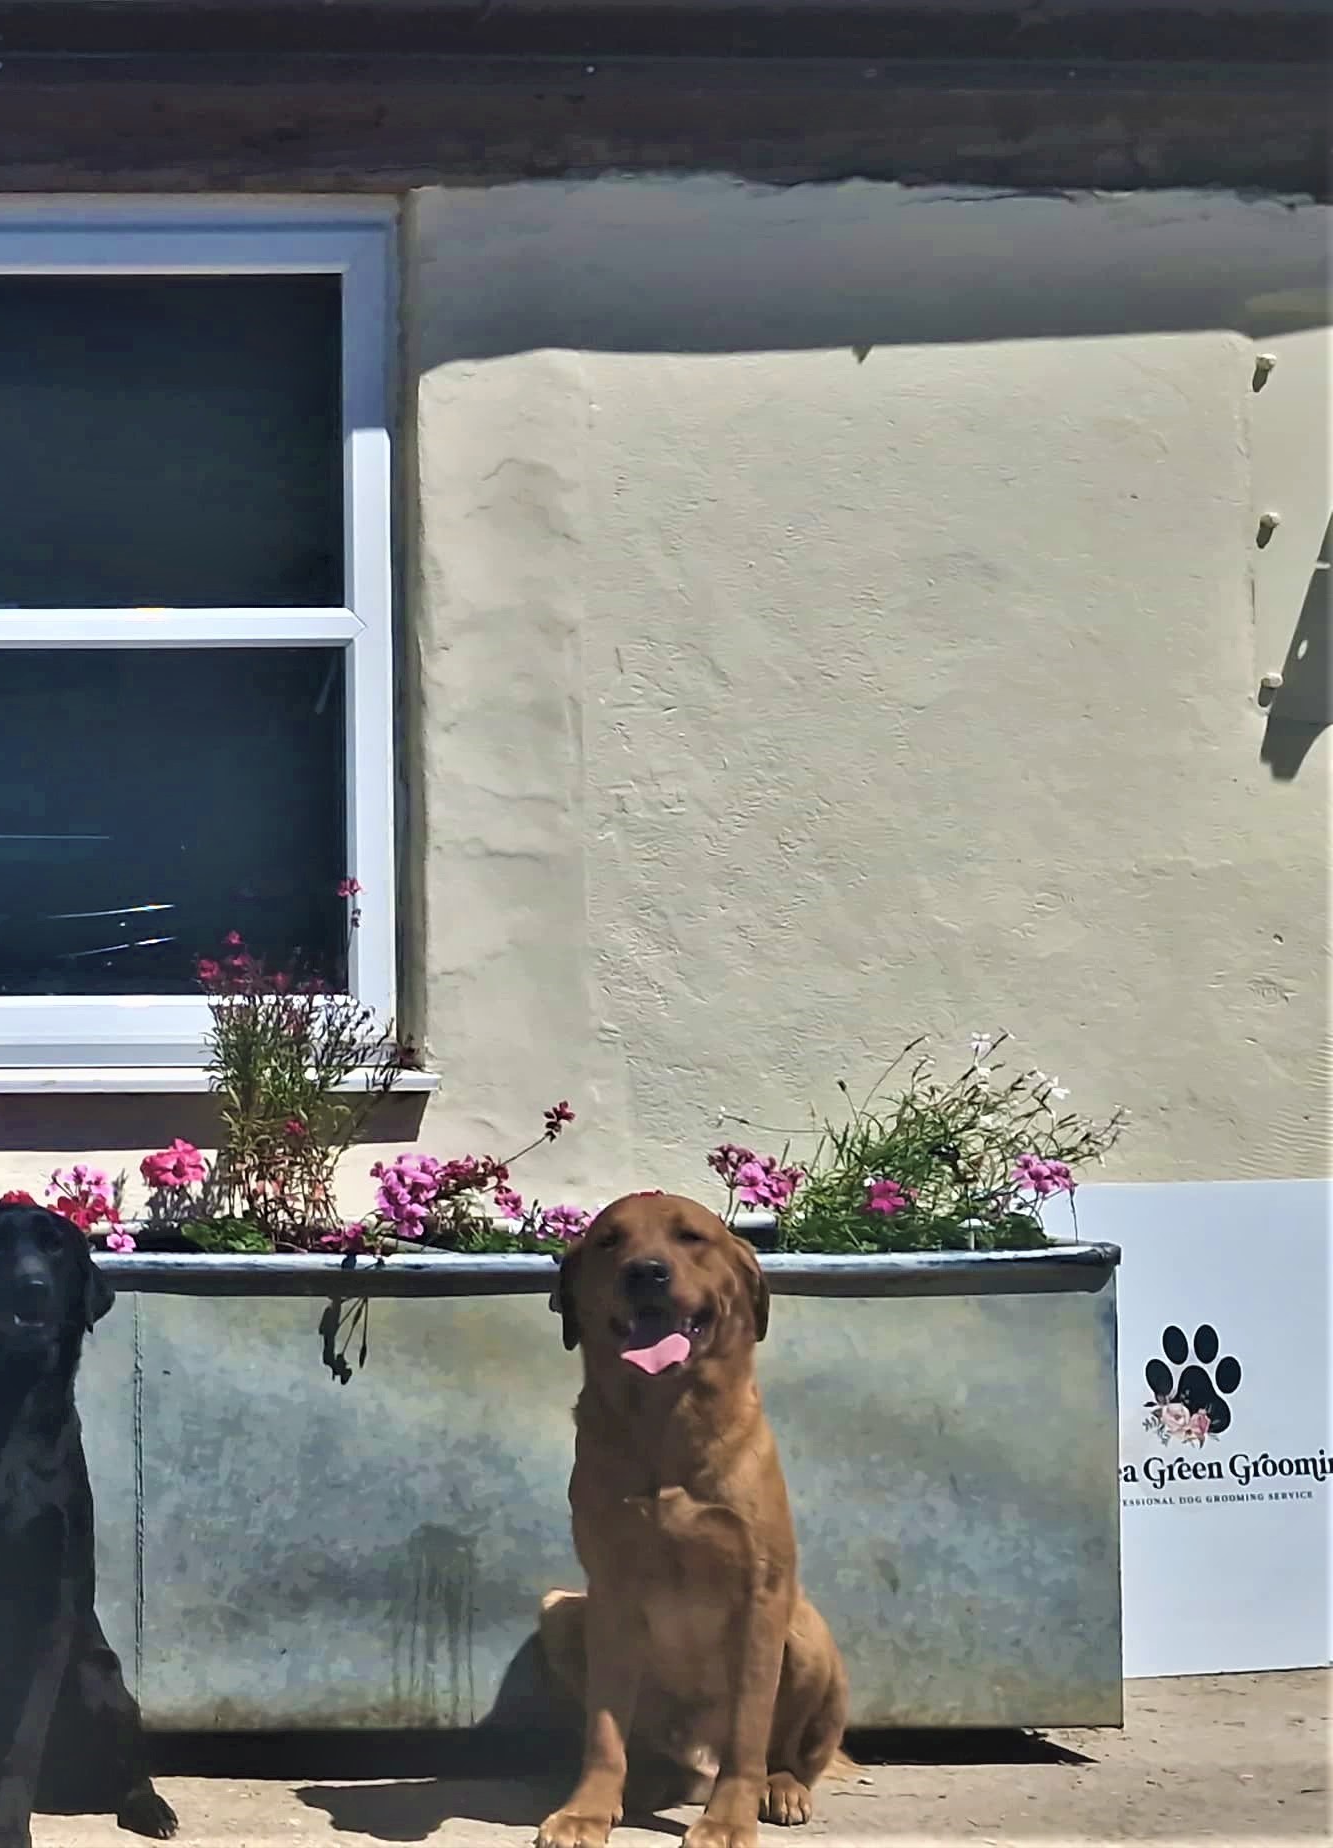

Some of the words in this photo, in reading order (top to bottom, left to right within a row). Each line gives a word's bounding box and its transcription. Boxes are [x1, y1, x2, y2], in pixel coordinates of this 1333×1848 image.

[1143, 1456, 1224, 1489] Green
[1179, 1495, 1202, 1504] DOG
[1205, 1492, 1264, 1503] GROOMING
[1268, 1490, 1312, 1500] SERVICE
